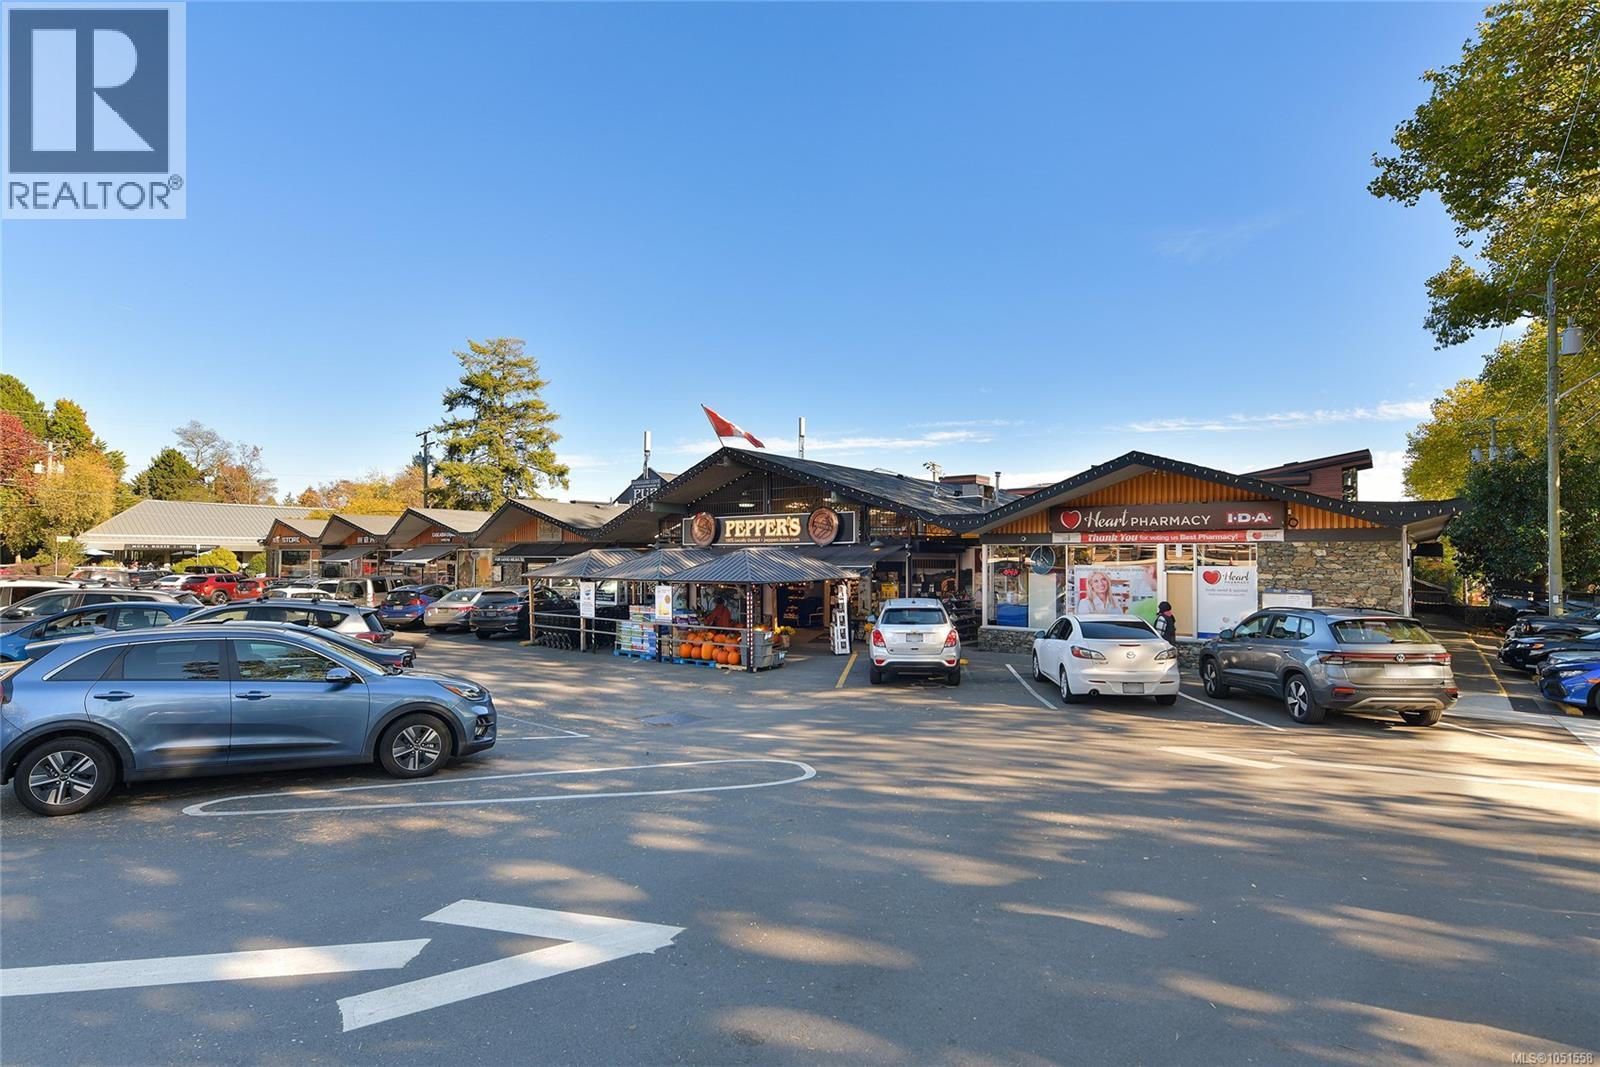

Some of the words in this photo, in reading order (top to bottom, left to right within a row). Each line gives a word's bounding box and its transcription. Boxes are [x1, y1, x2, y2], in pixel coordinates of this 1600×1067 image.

[1084, 509, 1129, 528] Heart
[1130, 514, 1211, 527] PHARMACY
[725, 516, 801, 537] PEPPER'S
[1088, 533, 1118, 542] Thank
[1119, 532, 1138, 542] You
[1149, 534, 1170, 543] voting
[1180, 533, 1196, 541] Best
[1197, 533, 1238, 543] Pharmacy!
[1222, 571, 1250, 581] Heart
